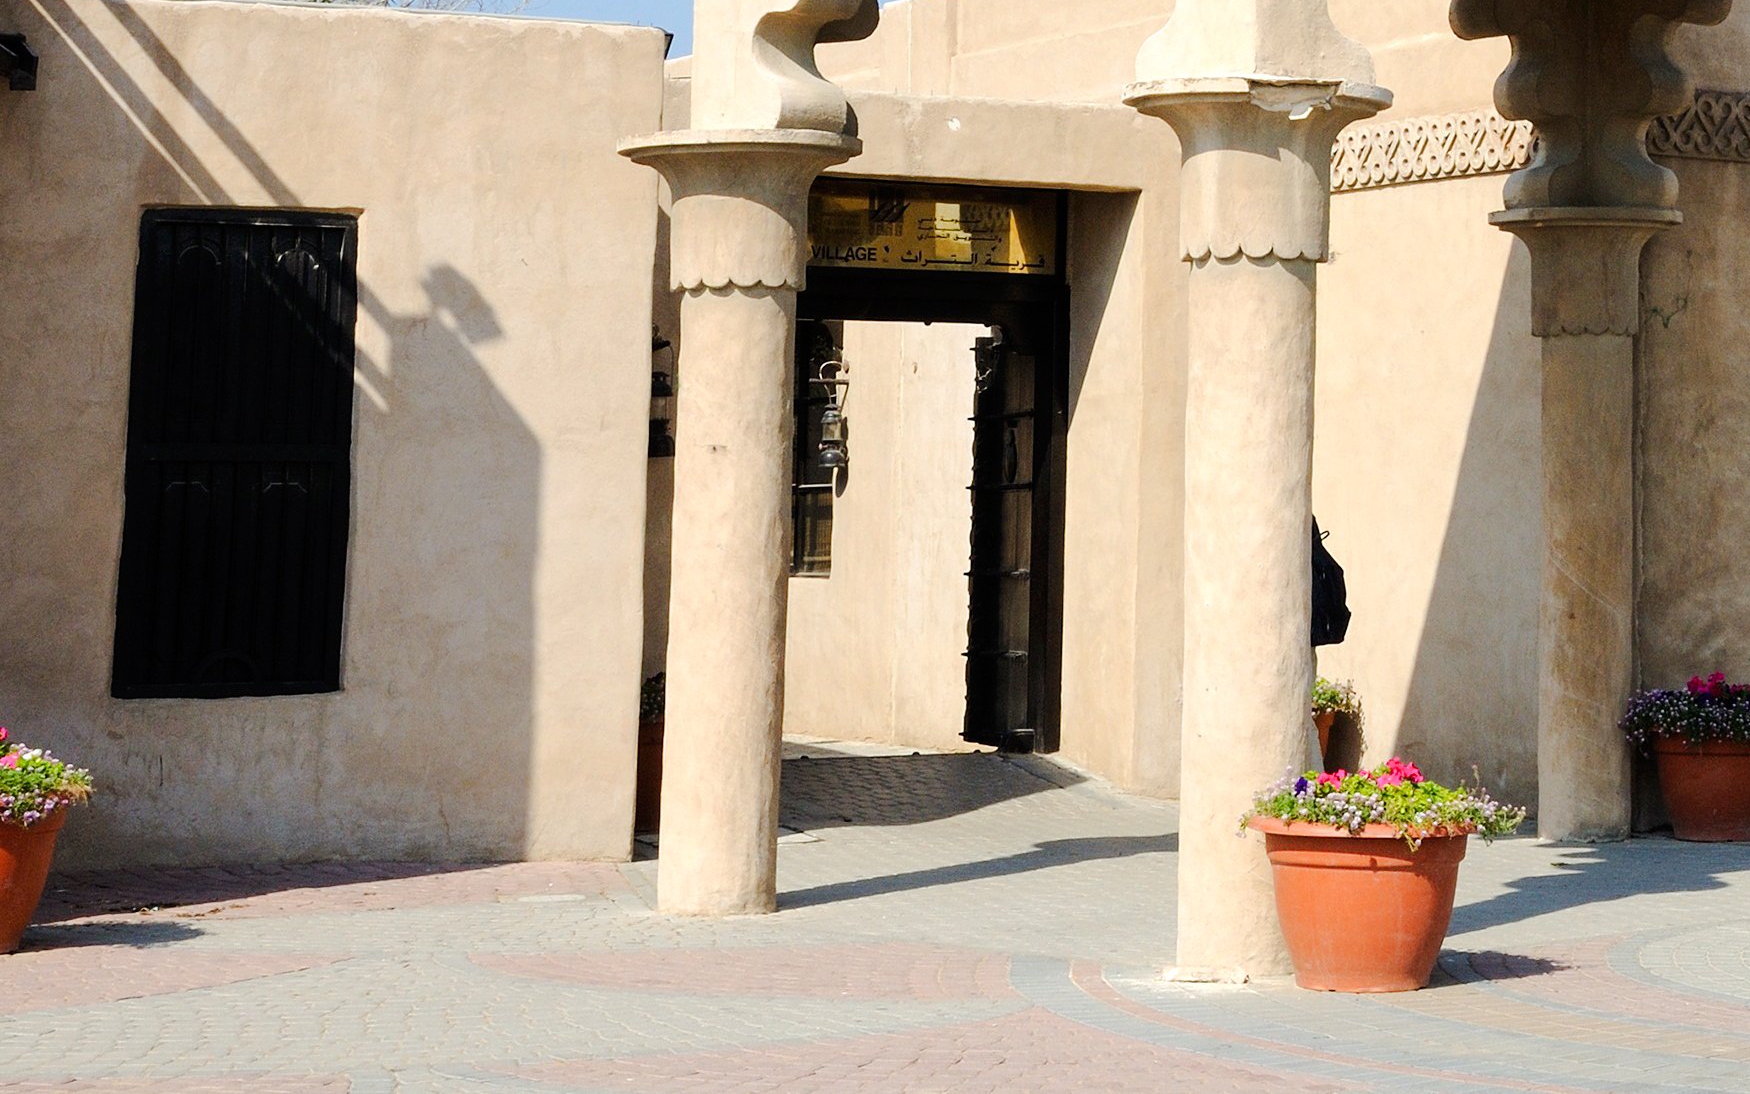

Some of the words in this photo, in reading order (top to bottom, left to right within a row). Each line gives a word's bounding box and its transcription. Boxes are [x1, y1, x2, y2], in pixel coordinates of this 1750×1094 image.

[811, 245, 878, 262] VILLAGE
[901, 249, 978, 267] التراث
[984, 253, 1046, 271] قرية
